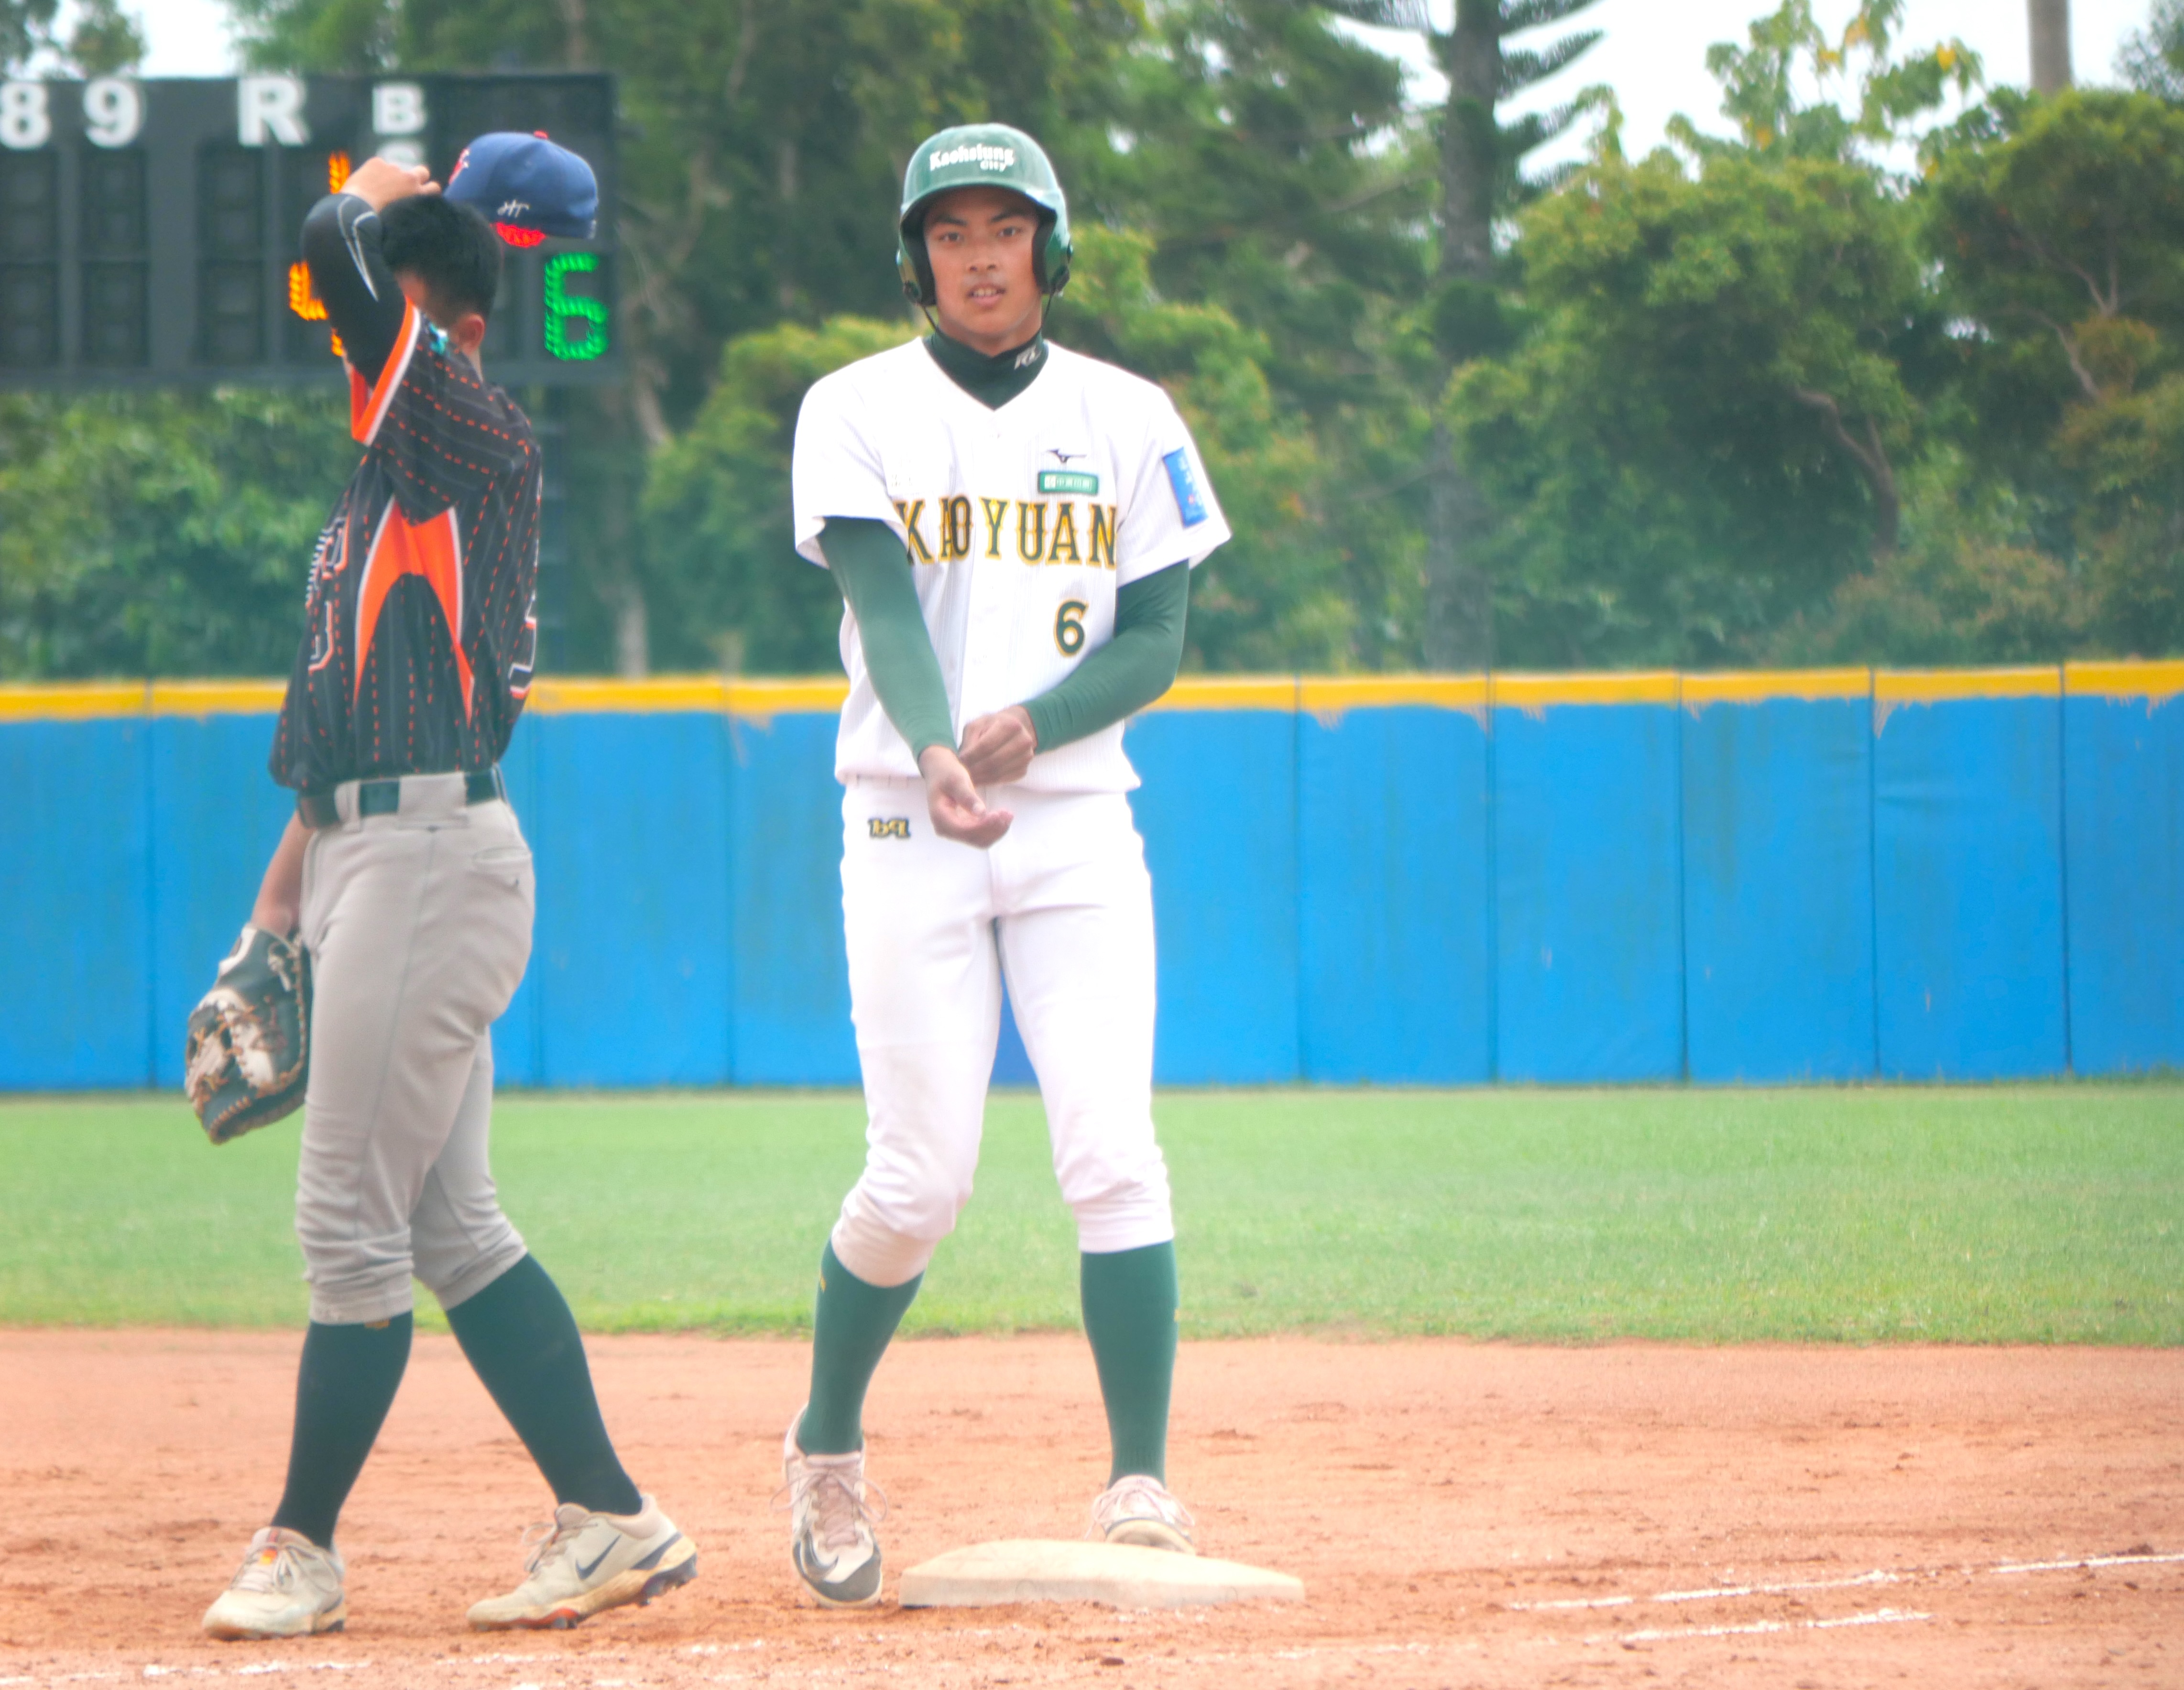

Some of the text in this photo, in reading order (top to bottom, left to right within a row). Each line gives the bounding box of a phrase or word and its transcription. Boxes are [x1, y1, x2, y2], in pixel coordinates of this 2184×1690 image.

[0, 78, 425, 149] 8 9 R B
[544, 252, 608, 360] 6
[1053, 599, 1089, 658] 6
